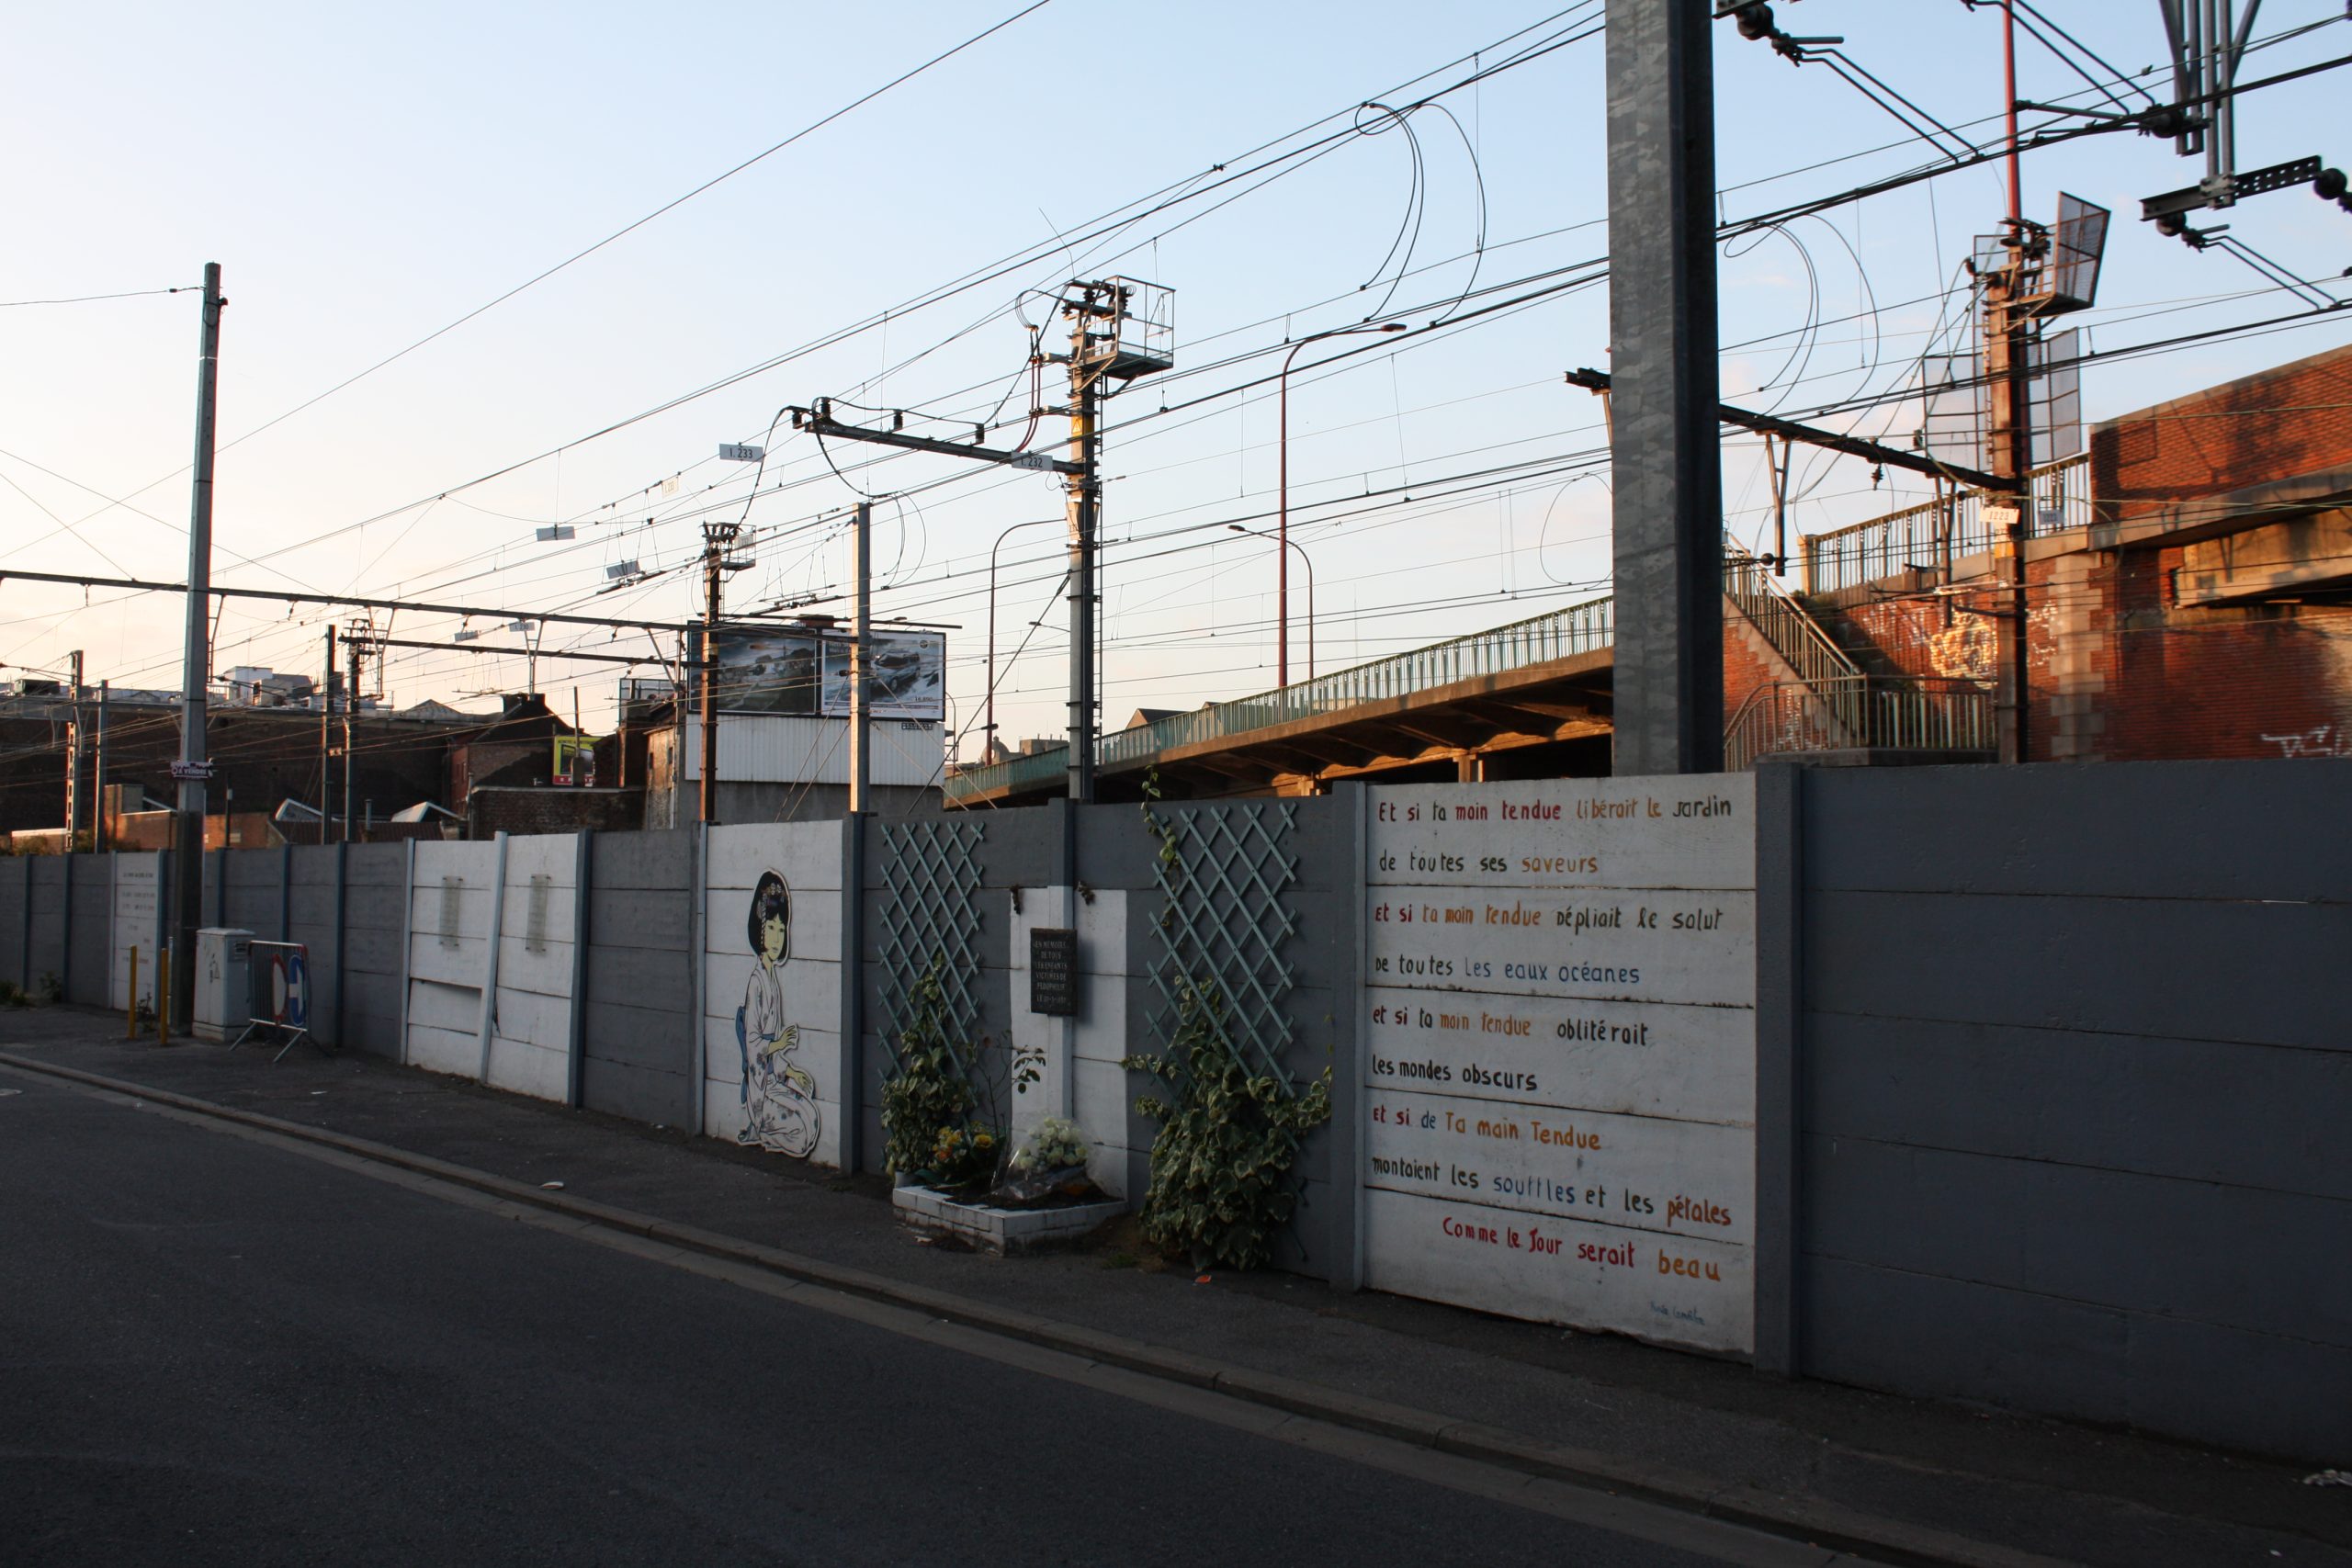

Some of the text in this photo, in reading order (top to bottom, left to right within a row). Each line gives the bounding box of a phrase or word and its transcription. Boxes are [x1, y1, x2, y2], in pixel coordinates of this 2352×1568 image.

[738, 448, 752, 458] 233
[1029, 457, 1042, 468] 232
[1379, 802, 1396, 821] Et
[1408, 803, 1419, 821] si
[1433, 801, 1446, 821] ta
[1455, 803, 1487, 820] main
[1502, 799, 1561, 820] tendue
[1577, 798, 1637, 818] libérait
[1647, 795, 1661, 818] le
[1380, 850, 1599, 873] de toutes ses saveurs
[1375, 903, 1389, 922] Et
[1399, 904, 1412, 922] si
[1423, 904, 1438, 922] ta
[1445, 906, 1474, 924] main
[1487, 900, 1542, 926] tendue
[1638, 908, 1657, 929] le
[1672, 908, 1724, 931] salut
[1400, 954, 1453, 976] toutes
[1505, 964, 1547, 980] eaux
[1559, 962, 1639, 983] océanes
[1374, 1005, 1386, 1024] et
[1396, 1008, 1408, 1025] si
[1420, 1008, 1432, 1028] ta
[1441, 1013, 1469, 1030] main
[1557, 1019, 1648, 1045] oblitérait
[1400, 1060, 1452, 1080] mondes
[1463, 1064, 1537, 1090] obscurs
[1374, 1105, 1600, 1150] Et si de Ta main Tendue
[1372, 1156, 1731, 1227] montaient les souffles et les pétales
[1443, 1217, 1720, 1281] Comme le Jour serait beau
